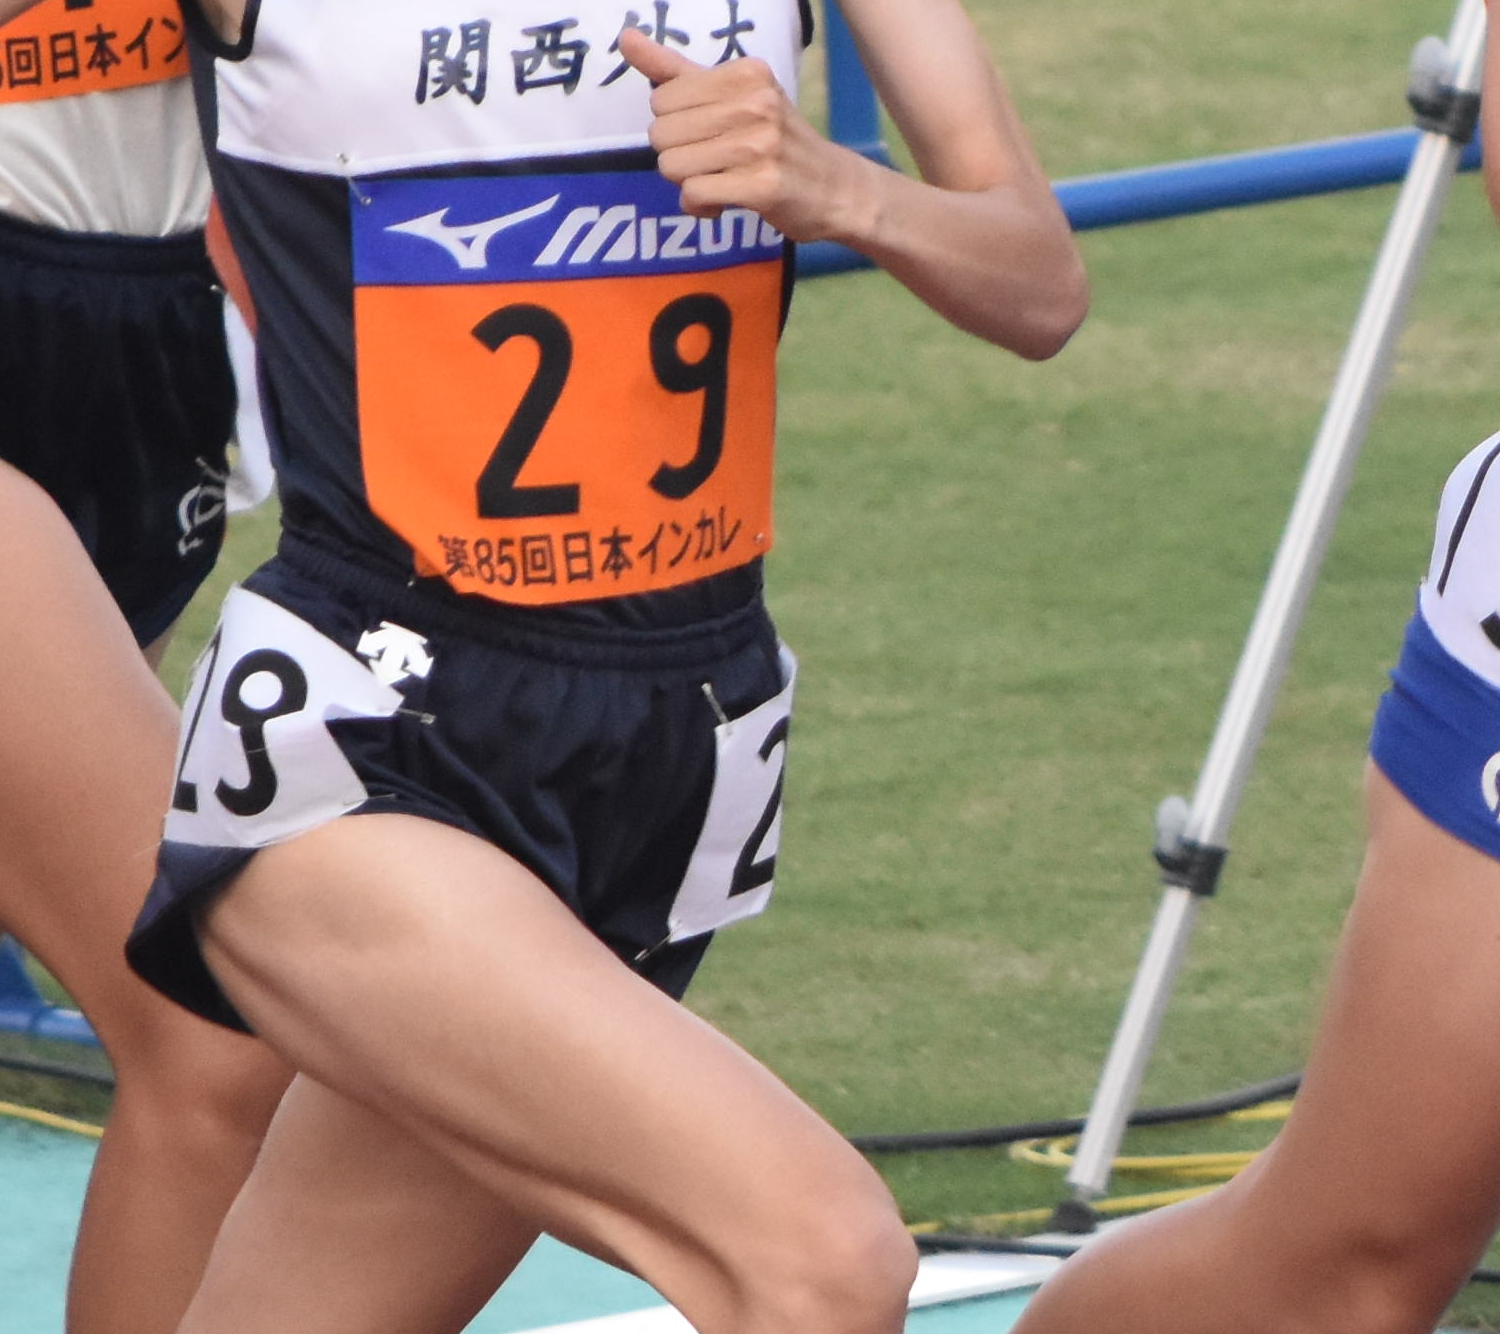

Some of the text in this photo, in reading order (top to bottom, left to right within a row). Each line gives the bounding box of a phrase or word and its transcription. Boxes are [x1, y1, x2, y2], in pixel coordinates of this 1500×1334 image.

[470, 292, 733, 519] 29
[437, 505, 742, 587] 第85回日本インカレ
